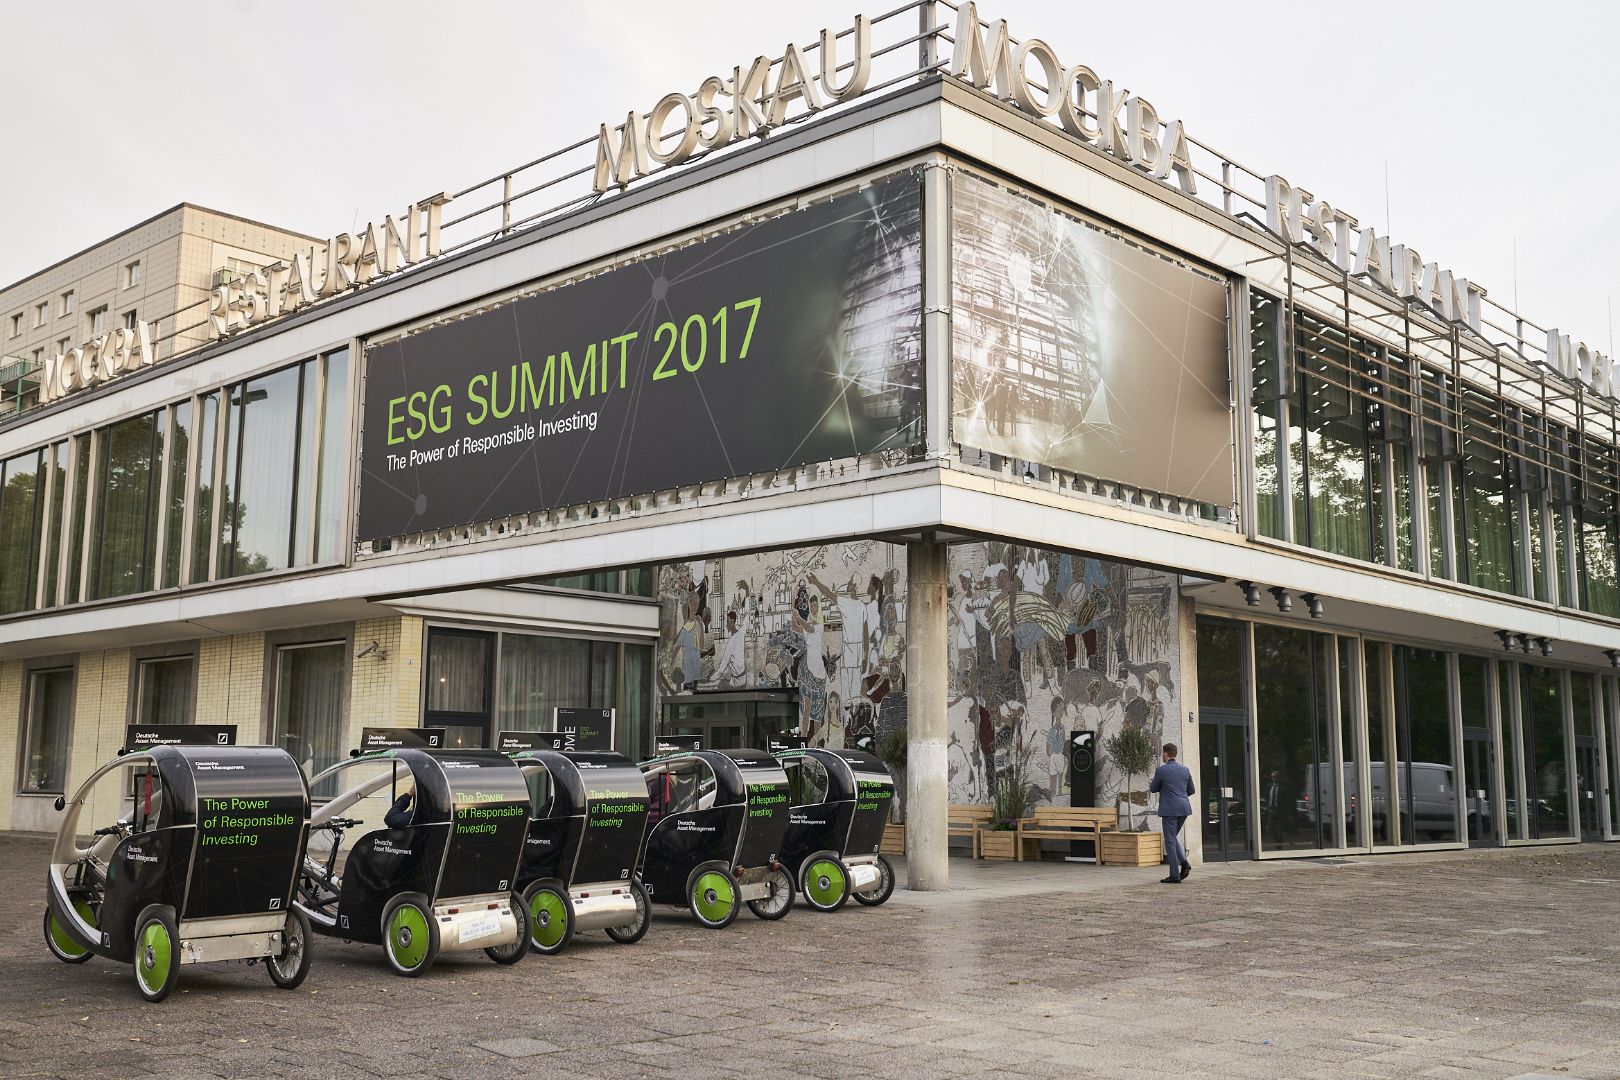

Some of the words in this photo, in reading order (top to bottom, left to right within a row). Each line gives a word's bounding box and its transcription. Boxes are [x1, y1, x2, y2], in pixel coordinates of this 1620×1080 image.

[592, 13, 871, 193] MOSKAU
[1265, 174, 1488, 338] RESTAURANT
[207, 192, 454, 340] RESTAURANT
[387, 384, 452, 446] ESG
[466, 332, 638, 425] SUMMIT
[652, 296, 763, 382] 2017
[387, 454, 406, 472] The
[410, 446, 445, 467] Power
[447, 439, 460, 458] of
[463, 424, 535, 455] Responsible
[539, 410, 598, 438] Investing
[749, 784, 759, 792] The
[760, 783, 775, 791] Power
[456, 792, 474, 803] The
[476, 792, 504, 802] Power
[590, 790, 606, 799] The
[606, 790, 629, 799] Power
[749, 797, 757, 805] of
[756, 794, 787, 805] Responsible
[859, 791, 866, 799] of
[865, 790, 891, 799] Responsible
[204, 798, 228, 811] The
[231, 798, 270, 810] Power
[591, 804, 600, 814] of
[601, 802, 644, 814] Responsible
[858, 802, 878, 811] Investing
[457, 807, 470, 819] of
[470, 806, 524, 820] Responsible
[749, 808, 773, 818] Investing
[204, 816, 218, 829] of
[221, 814, 294, 829] Responsible
[590, 818, 623, 828] Investing
[456, 823, 497, 834] Investing
[202, 832, 258, 846] Investing
[375, 838, 393, 847] Deutsche
[385, 846, 412, 855] Management
